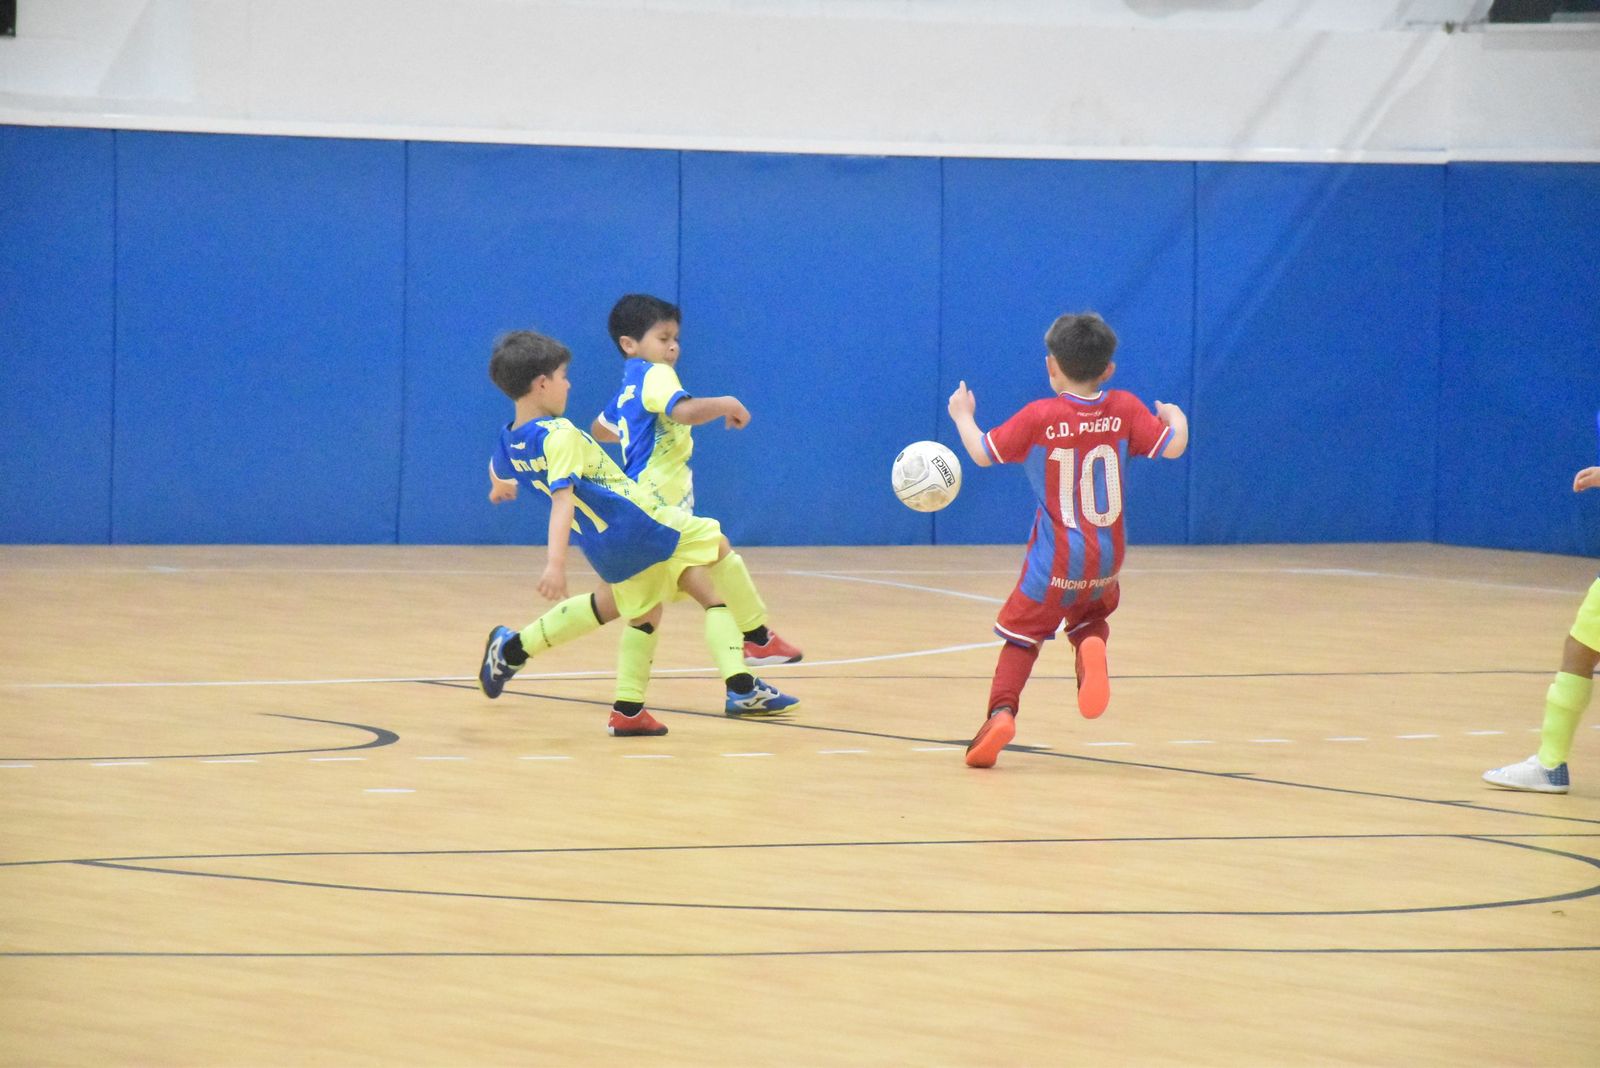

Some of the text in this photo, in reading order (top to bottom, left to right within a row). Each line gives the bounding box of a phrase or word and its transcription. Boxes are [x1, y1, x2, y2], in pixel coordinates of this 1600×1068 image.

[1045, 416, 1122, 440] C.D. PUERO
[934, 456, 955, 487] MUNICH
[1048, 444, 1122, 529] 10
[1050, 576, 1087, 590] MUCHO
